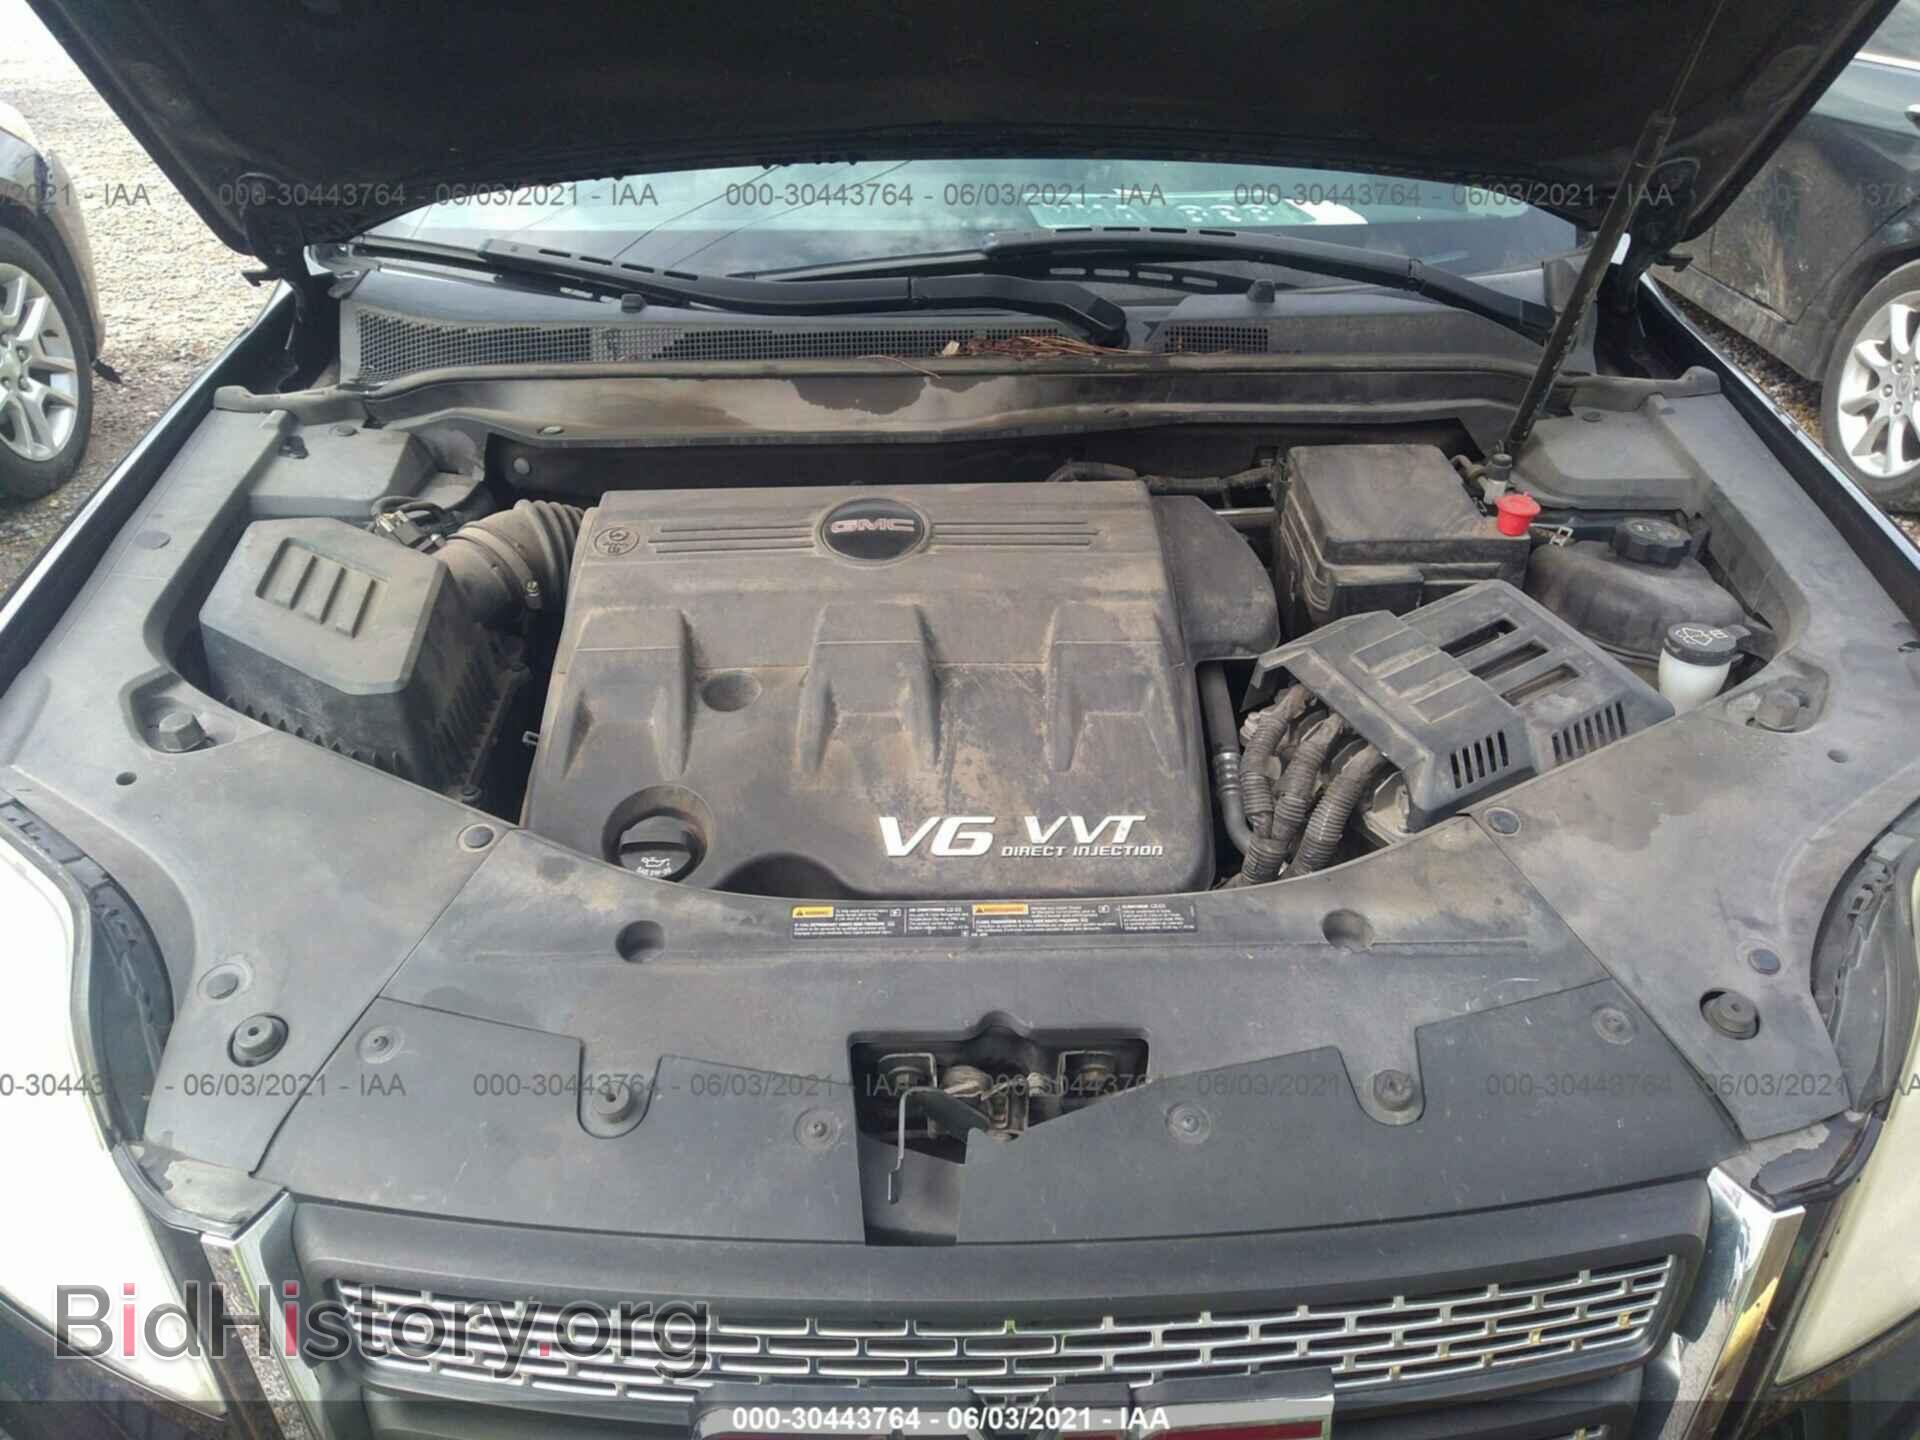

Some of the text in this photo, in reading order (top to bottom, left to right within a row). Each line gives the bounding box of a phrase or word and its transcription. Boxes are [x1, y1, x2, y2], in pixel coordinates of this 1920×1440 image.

[831, 518, 915, 533] GMC
[878, 815, 1147, 857] V6 VVT
[1001, 845, 1164, 857] DIRECT INJECTION
